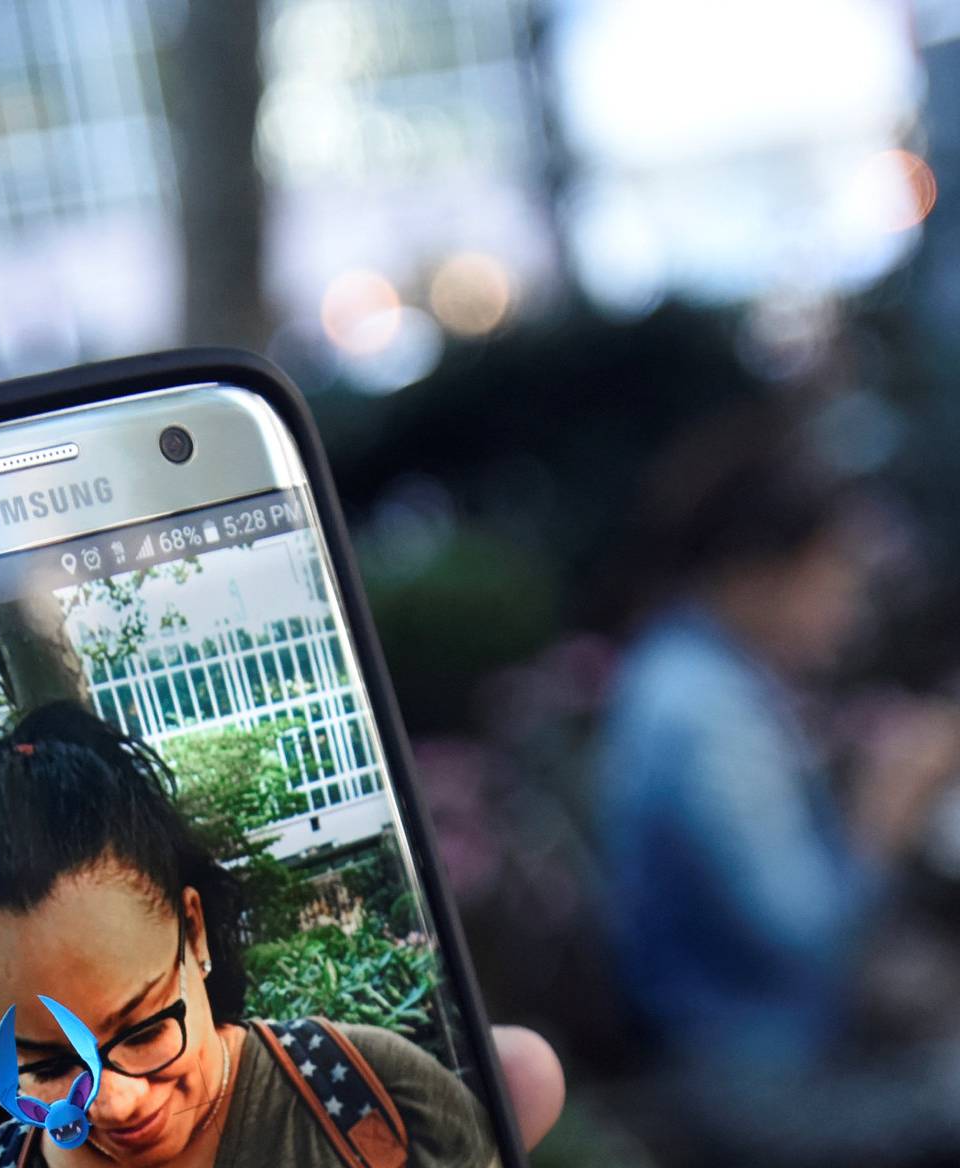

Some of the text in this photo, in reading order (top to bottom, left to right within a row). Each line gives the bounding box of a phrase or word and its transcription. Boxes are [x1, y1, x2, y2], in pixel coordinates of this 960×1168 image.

[159, 501, 301, 553] 68% 5:28 PM
